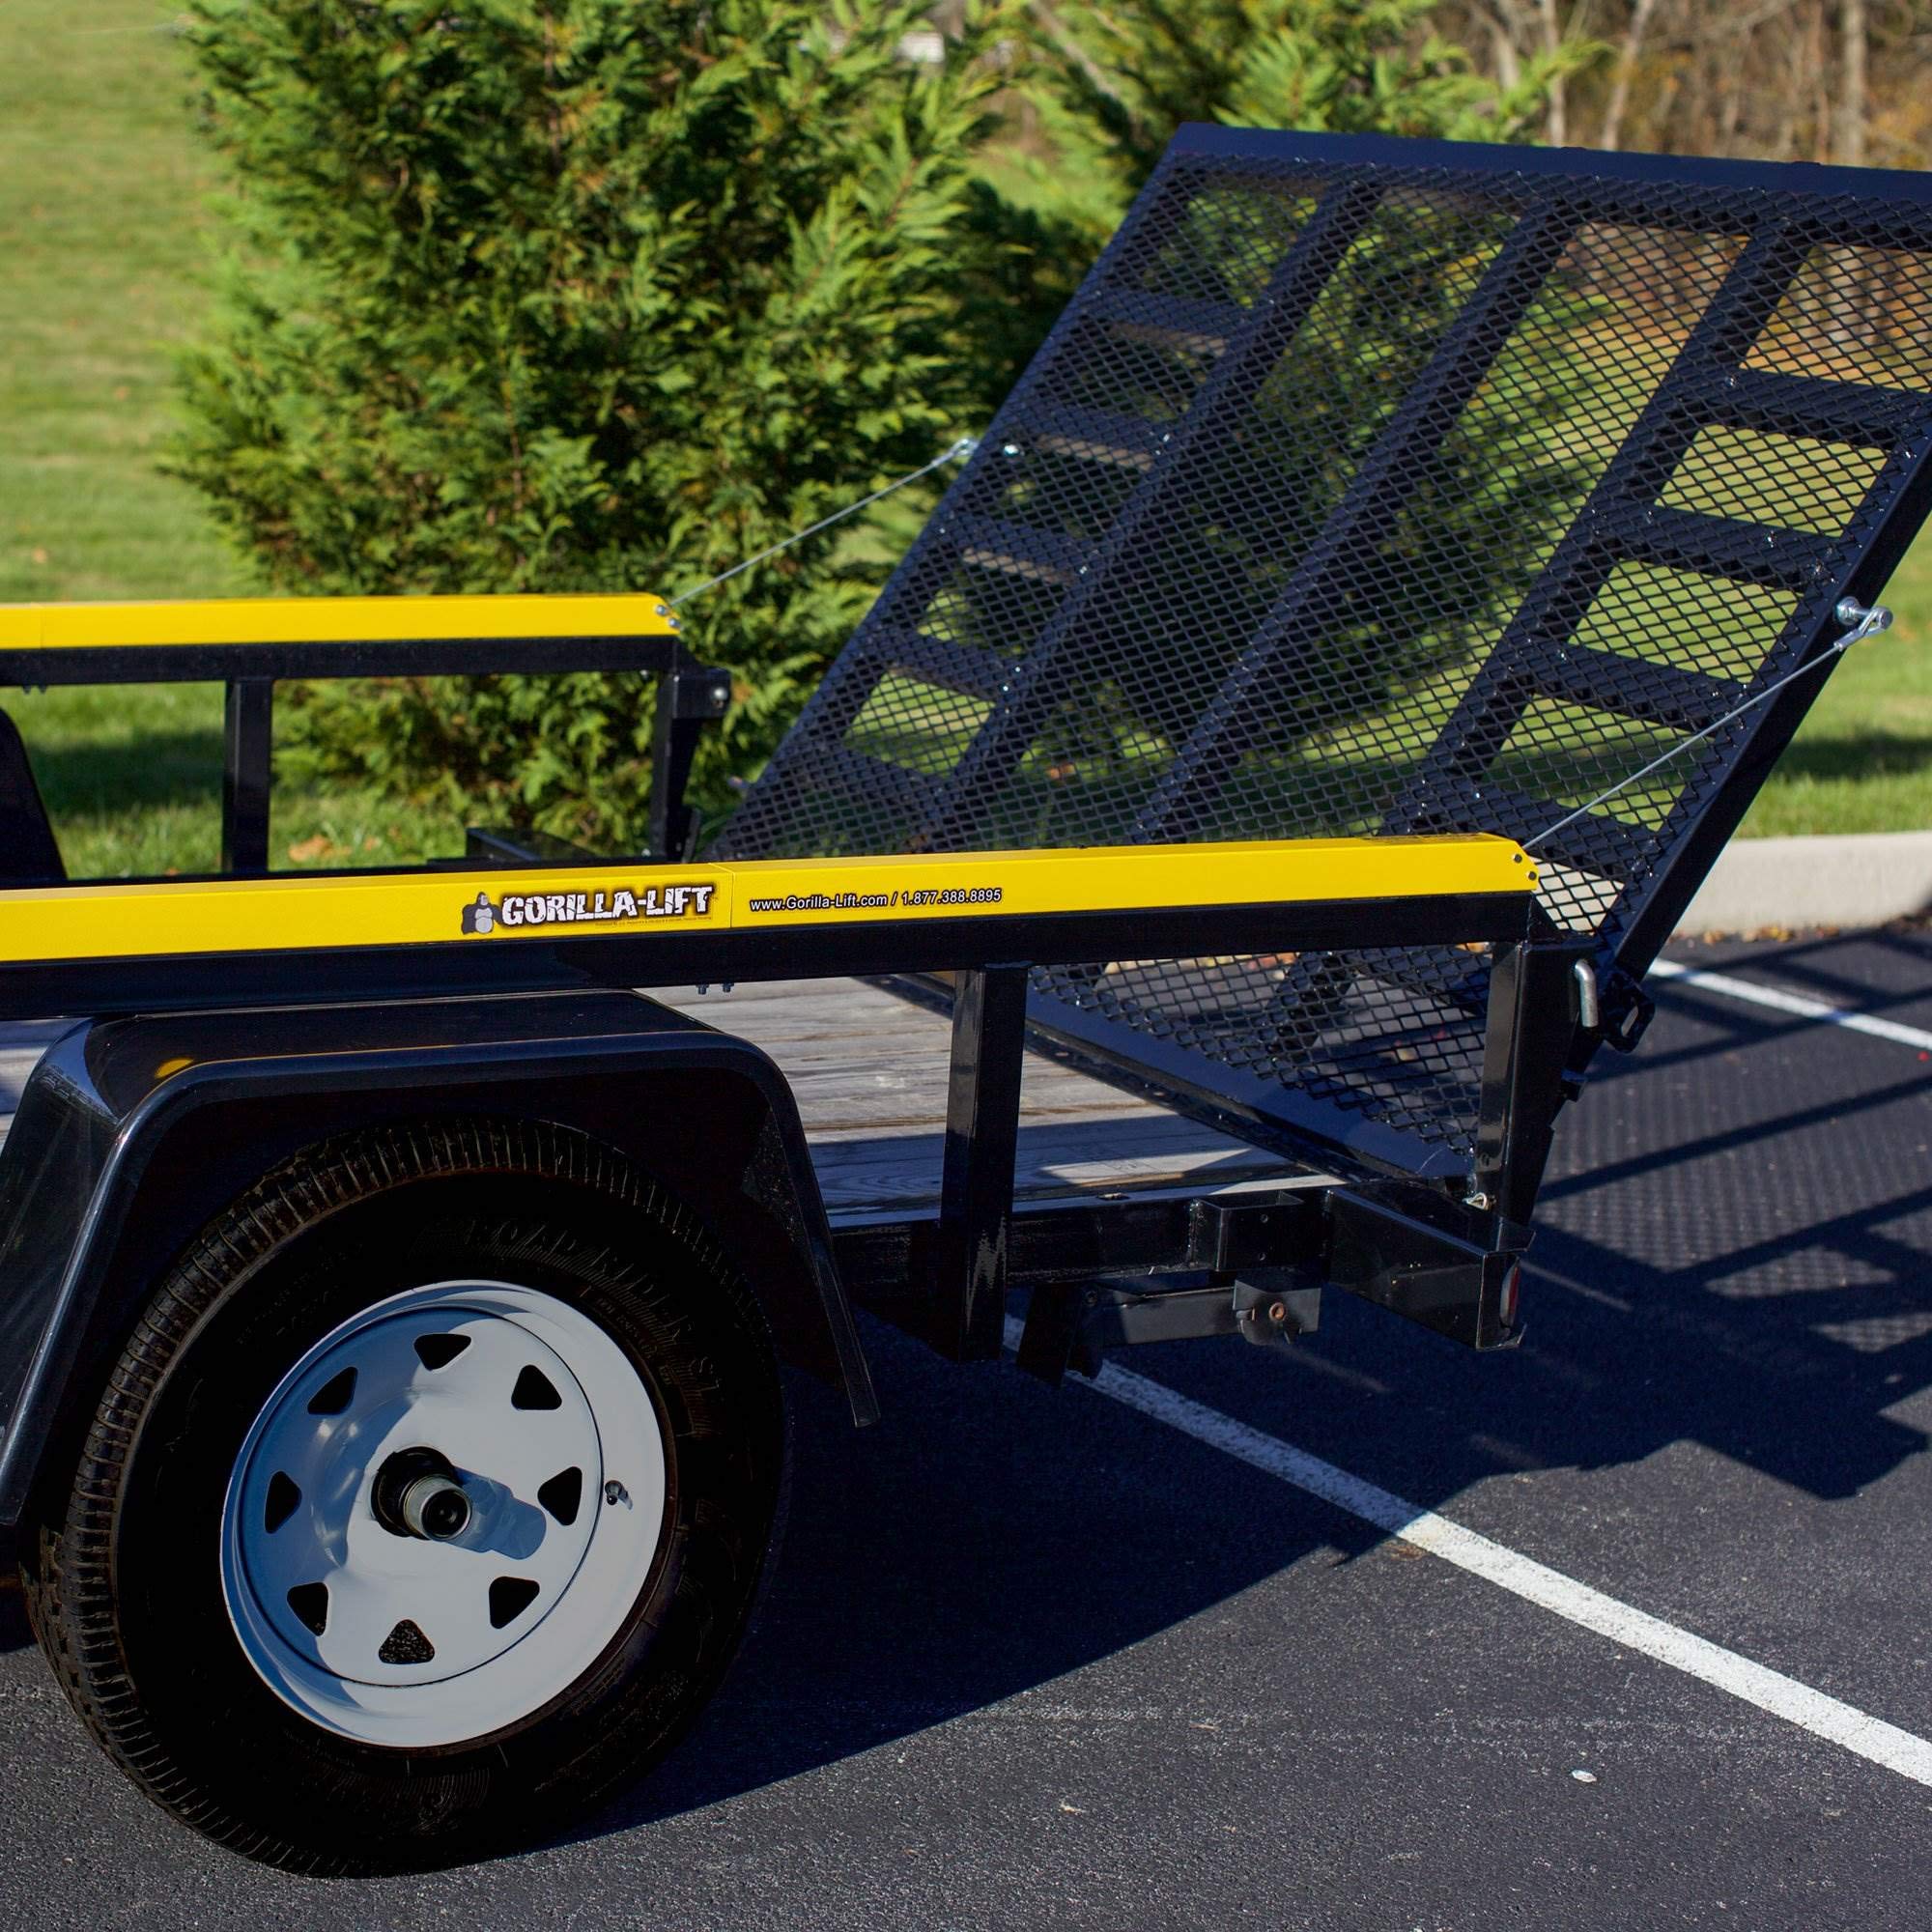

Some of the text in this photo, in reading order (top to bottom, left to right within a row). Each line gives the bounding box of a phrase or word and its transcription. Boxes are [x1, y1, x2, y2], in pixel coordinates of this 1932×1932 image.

[501, 886, 712, 925] GORILLA-LIFT
[751, 894, 887, 911] www.Gorilla-Lift.com
[902, 889, 1002, 906] 1.877.388.8895
